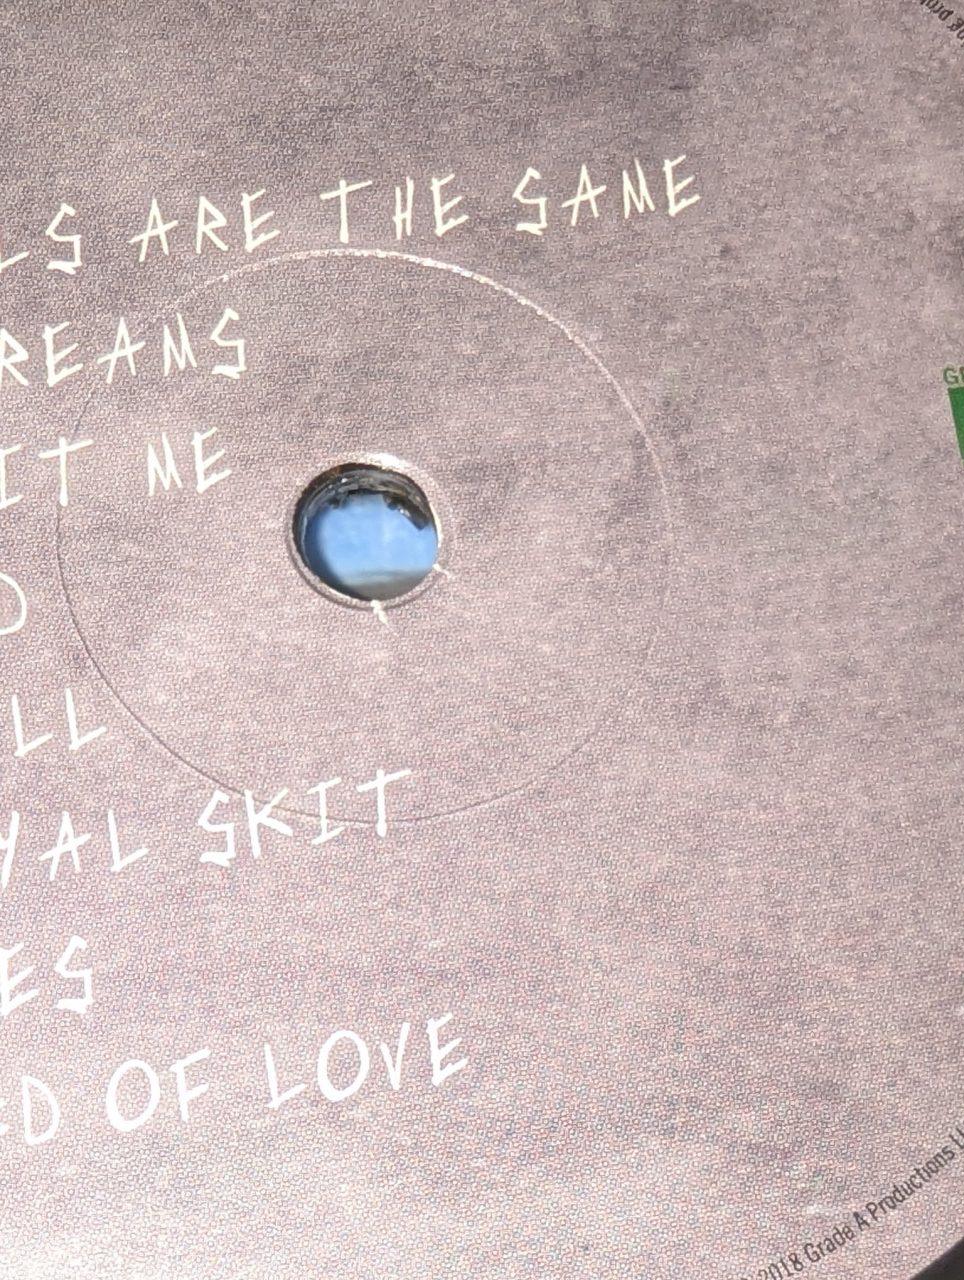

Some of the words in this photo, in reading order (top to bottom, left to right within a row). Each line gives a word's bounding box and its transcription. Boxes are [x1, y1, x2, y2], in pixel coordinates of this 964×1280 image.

[129, 189, 281, 262] ARE
[319, 174, 469, 243] THE
[513, 155, 701, 235] SAME
[146, 428, 232, 496] ME
[804, 1225, 855, 1263] Grade
[853, 1212, 871, 1232] A
[866, 1145, 956, 1222] Productions
[920, 0, 954, 21] pro
[12, 688, 107, 757] LL
[199, 769, 412, 867] SKIT
[0, 1075, 60, 1146] D
[105, 1048, 211, 1132] OF
[264, 1013, 468, 1109] LOVE
